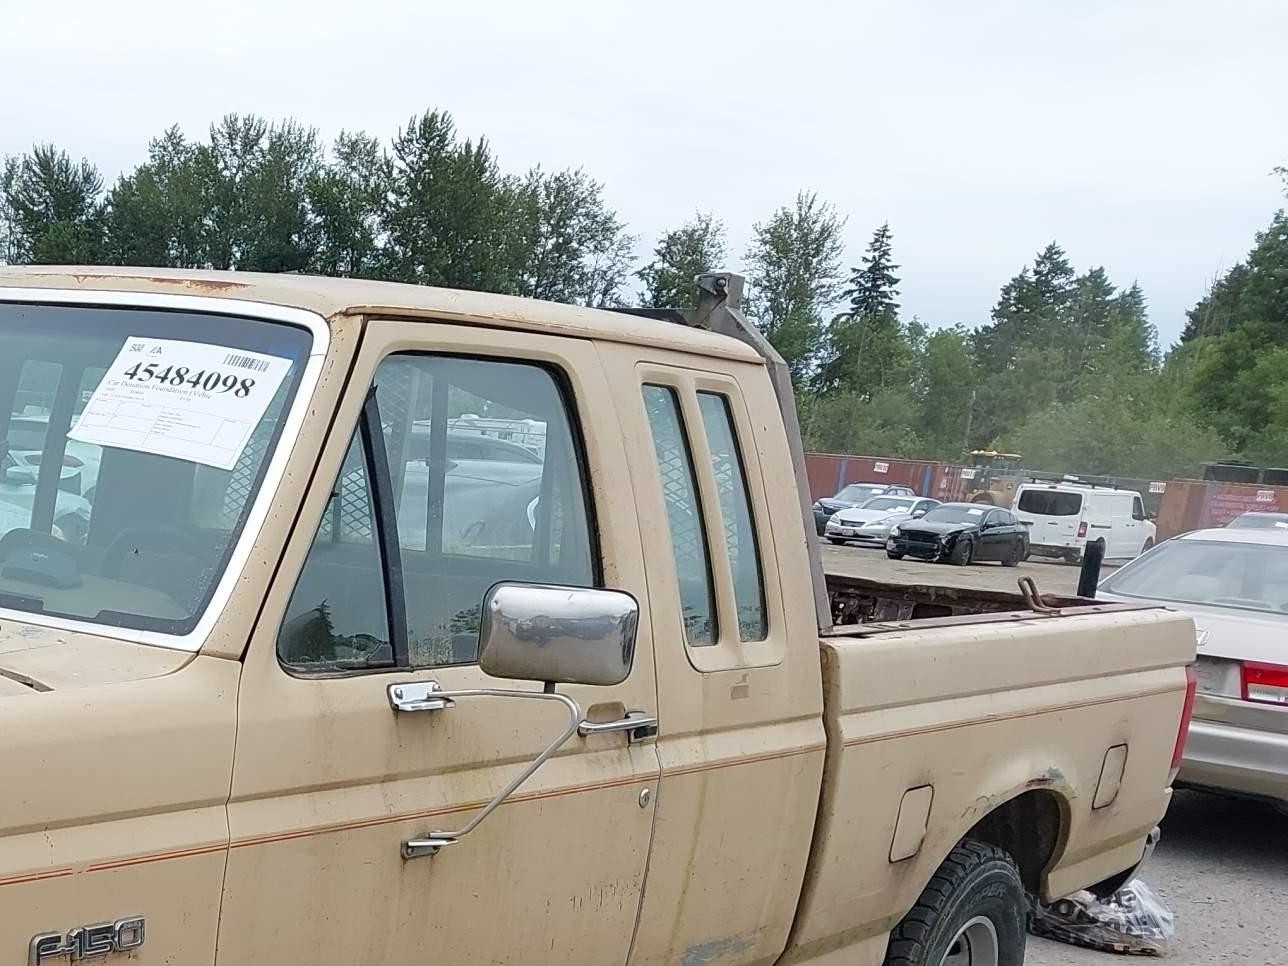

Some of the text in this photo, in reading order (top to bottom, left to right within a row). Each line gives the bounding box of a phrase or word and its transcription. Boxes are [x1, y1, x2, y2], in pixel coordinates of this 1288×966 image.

[121, 380, 150, 389] Donation
[152, 384, 188, 395] Foundation
[123, 361, 256, 398] 45484098
